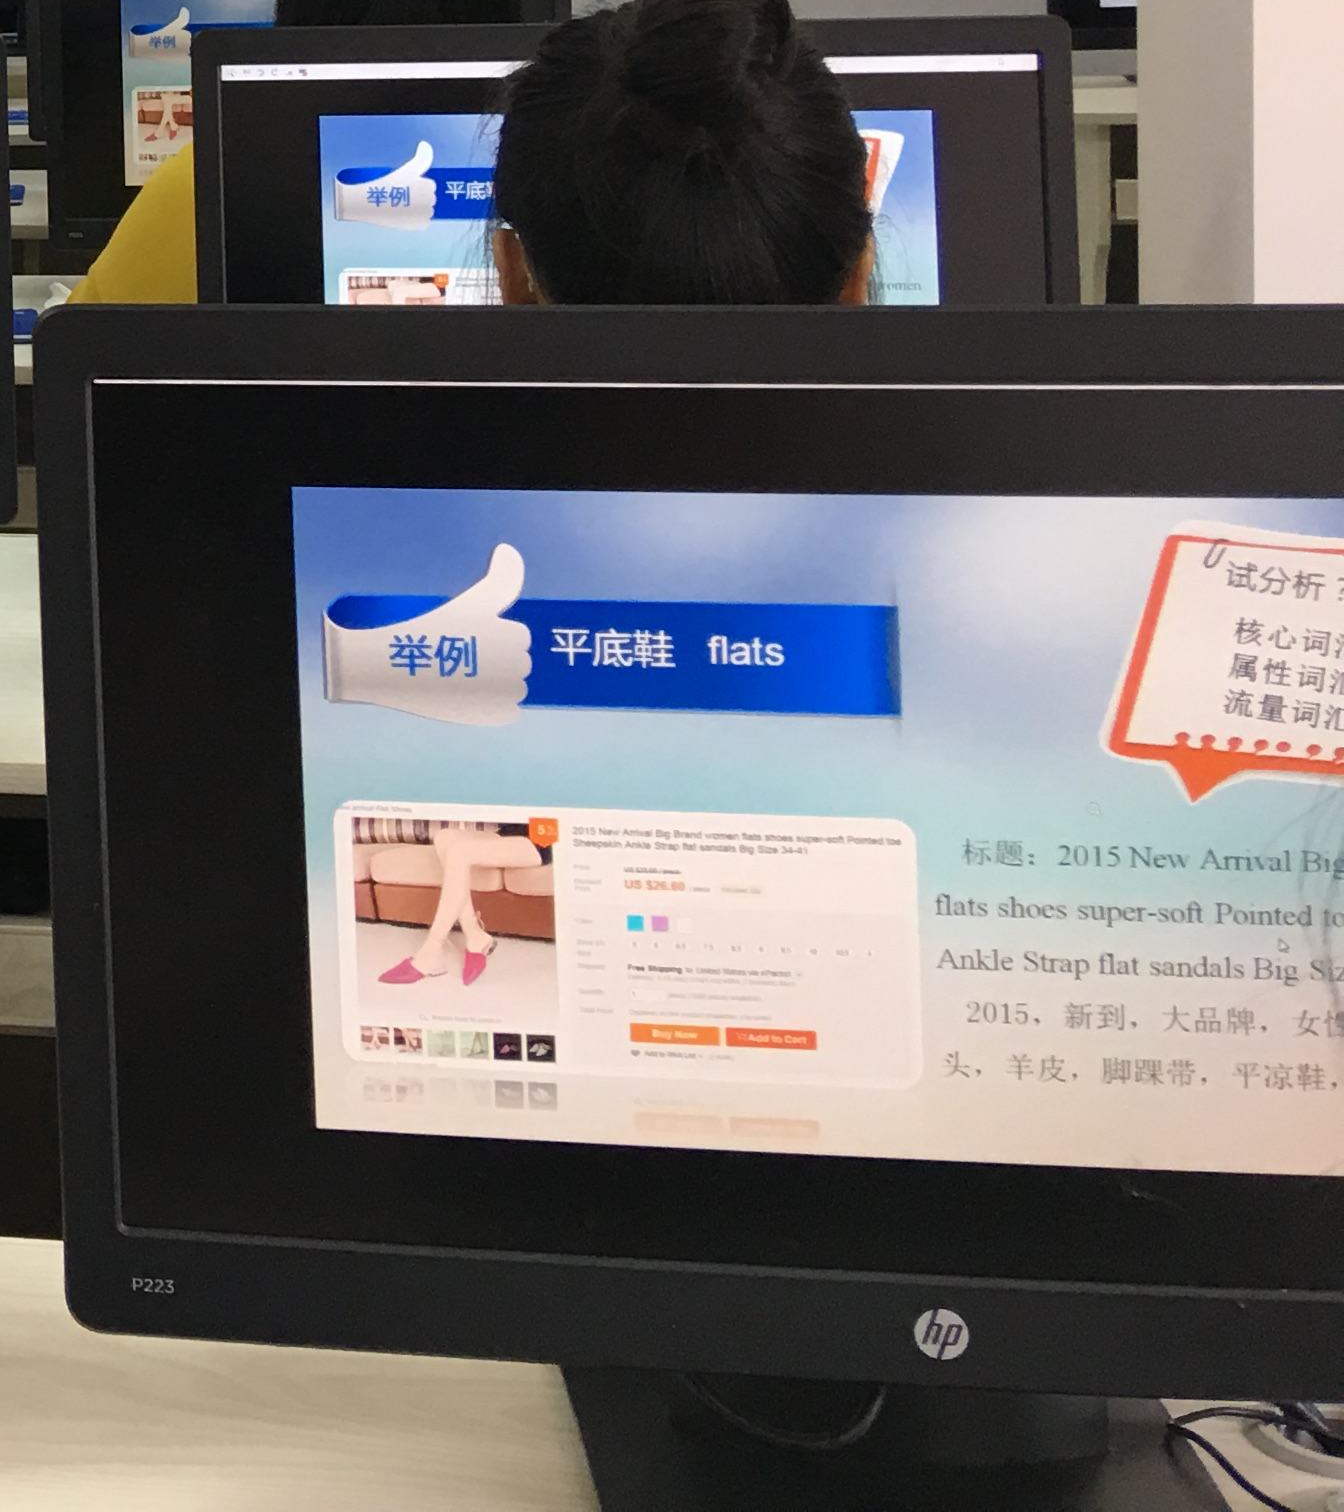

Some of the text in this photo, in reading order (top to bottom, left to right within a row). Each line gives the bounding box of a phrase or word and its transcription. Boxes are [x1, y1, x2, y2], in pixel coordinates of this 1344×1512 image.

[366, 186, 411, 207] 举例
[387, 634, 479, 678] 举例
[550, 628, 786, 669] 平底鞋 flats
[1129, 845, 1190, 869] New
[1199, 848, 1291, 873] Arrival
[1300, 848, 1344, 881] Big
[935, 892, 988, 918] flats
[997, 896, 1067, 920] shoes
[1076, 899, 1203, 928] super-soft
[1214, 901, 1313, 927] Pointed
[936, 947, 1013, 972] Ankle
[1023, 950, 1090, 980] Strap
[1098, 952, 1139, 976] flat
[1149, 956, 1245, 979] sandals
[1252, 956, 1299, 987] Big
[132, 1277, 175, 1294] P223
[919, 1308, 966, 1360] hp
